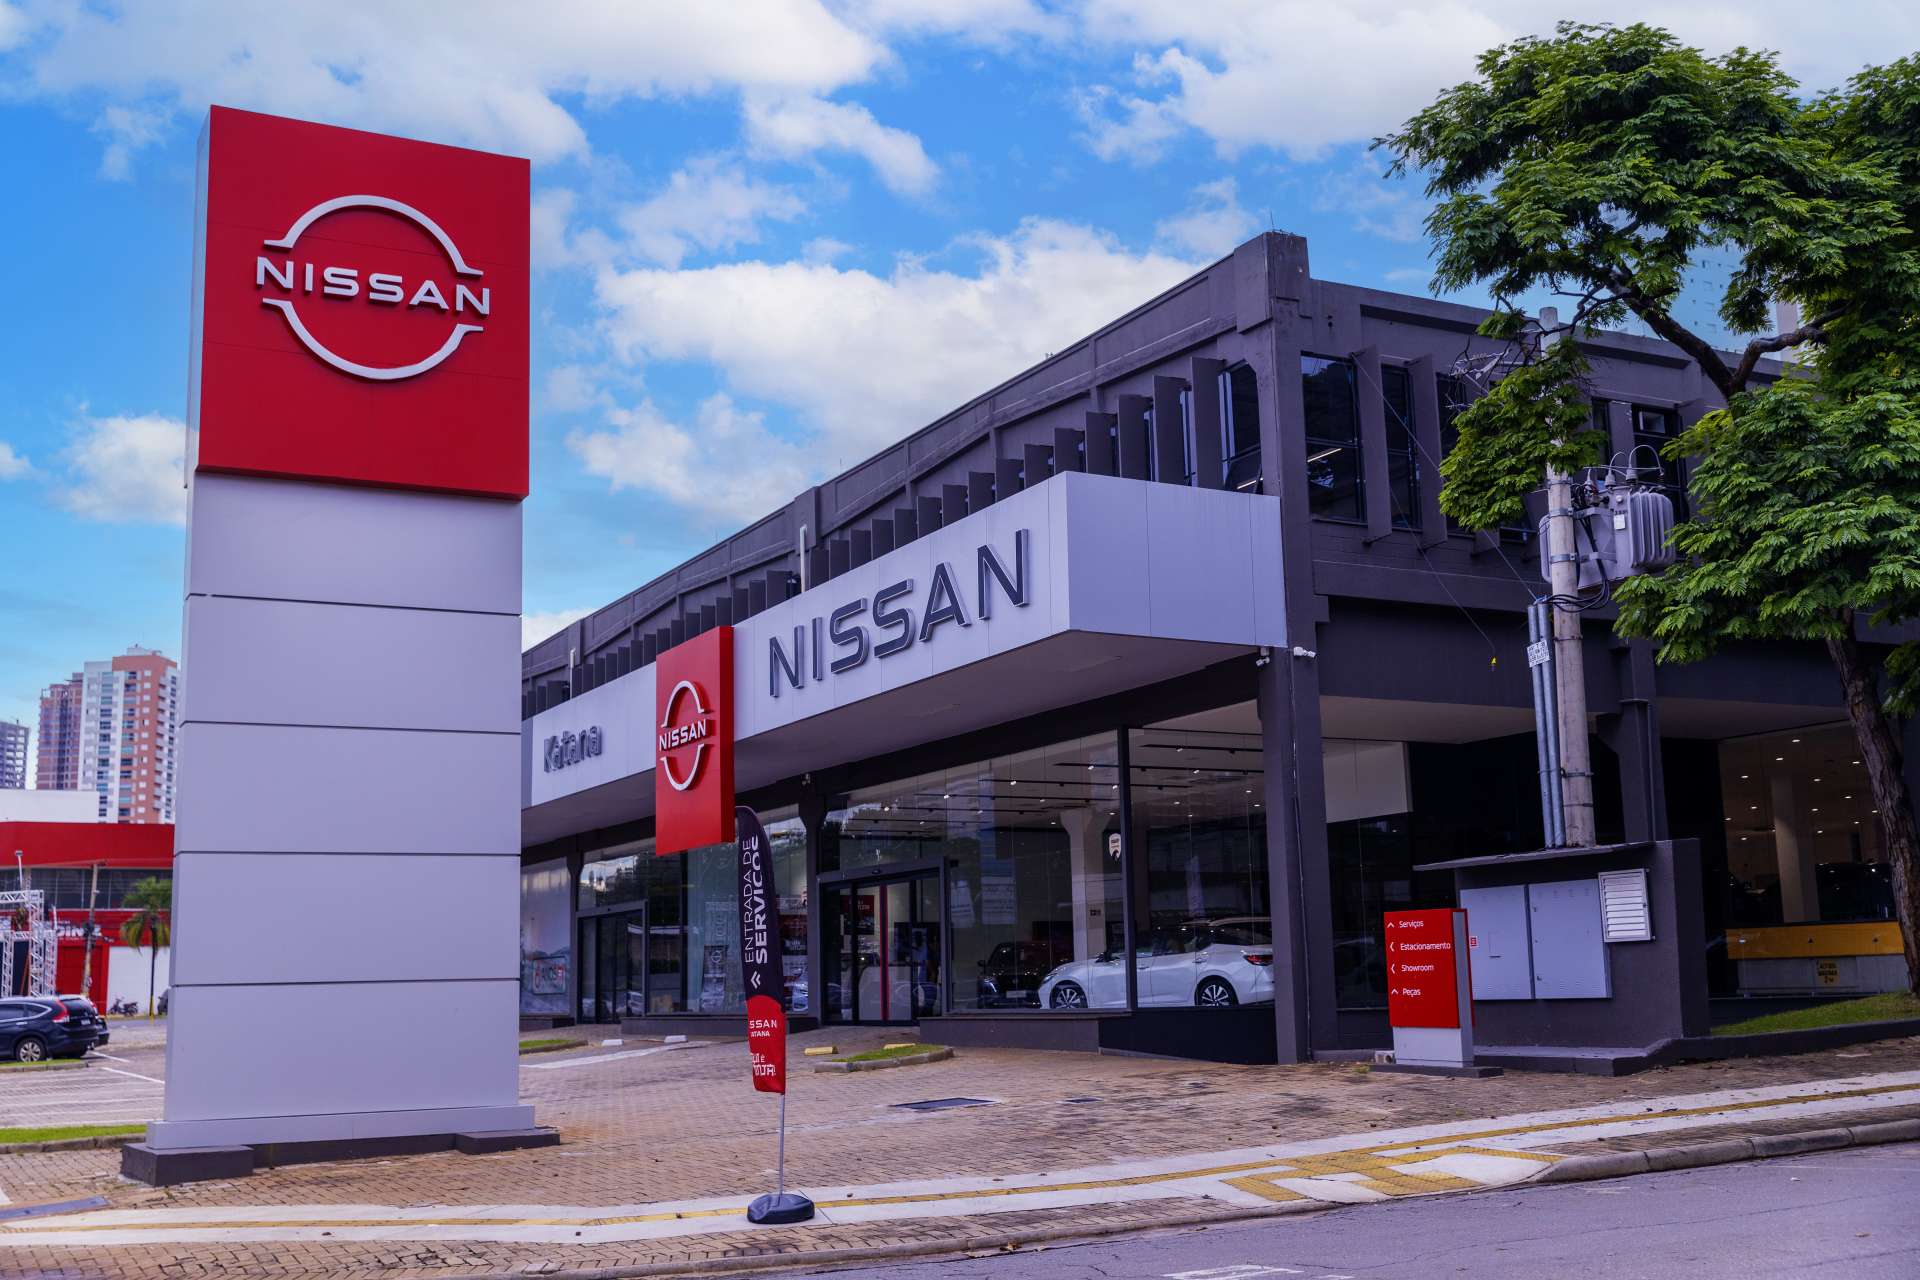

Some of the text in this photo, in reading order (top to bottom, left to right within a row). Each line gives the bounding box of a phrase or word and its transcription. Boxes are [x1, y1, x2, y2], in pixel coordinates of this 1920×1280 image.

[256, 256, 490, 315] NISSAN
[769, 528, 1029, 698] NISSAN
[543, 725, 602, 773] Katana
[659, 719, 707, 751] NISSAN
[743, 839, 755, 963] ENTRADA DE
[1399, 920, 1424, 929] Serviços
[1400, 942, 1451, 951] Estacionamento
[1401, 964, 1435, 972] Showroom
[1402, 987, 1421, 997] Peças
